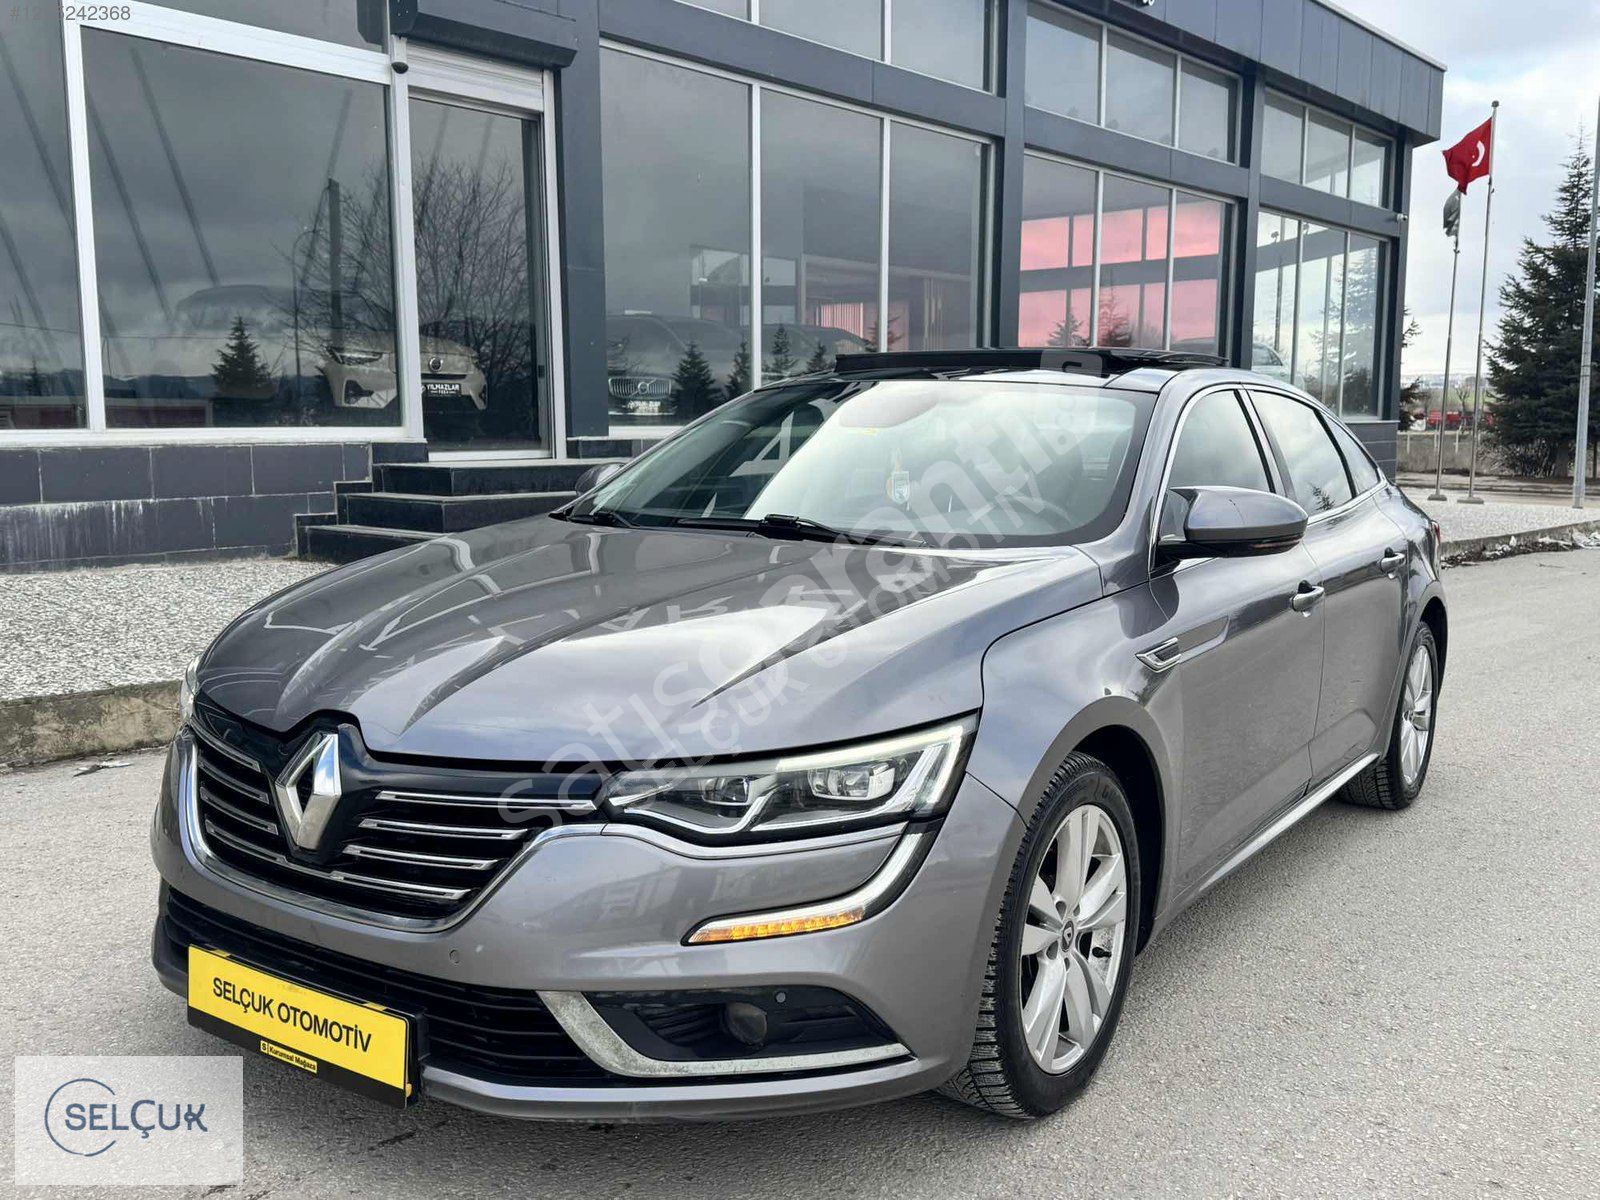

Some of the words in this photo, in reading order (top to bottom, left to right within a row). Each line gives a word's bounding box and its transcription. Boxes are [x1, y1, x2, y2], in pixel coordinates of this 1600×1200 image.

[212, 977, 275, 1019] SELÇUK
[277, 1003, 372, 1053] OTOMOTİV
[269, 1046, 294, 1062] Kurumsal
